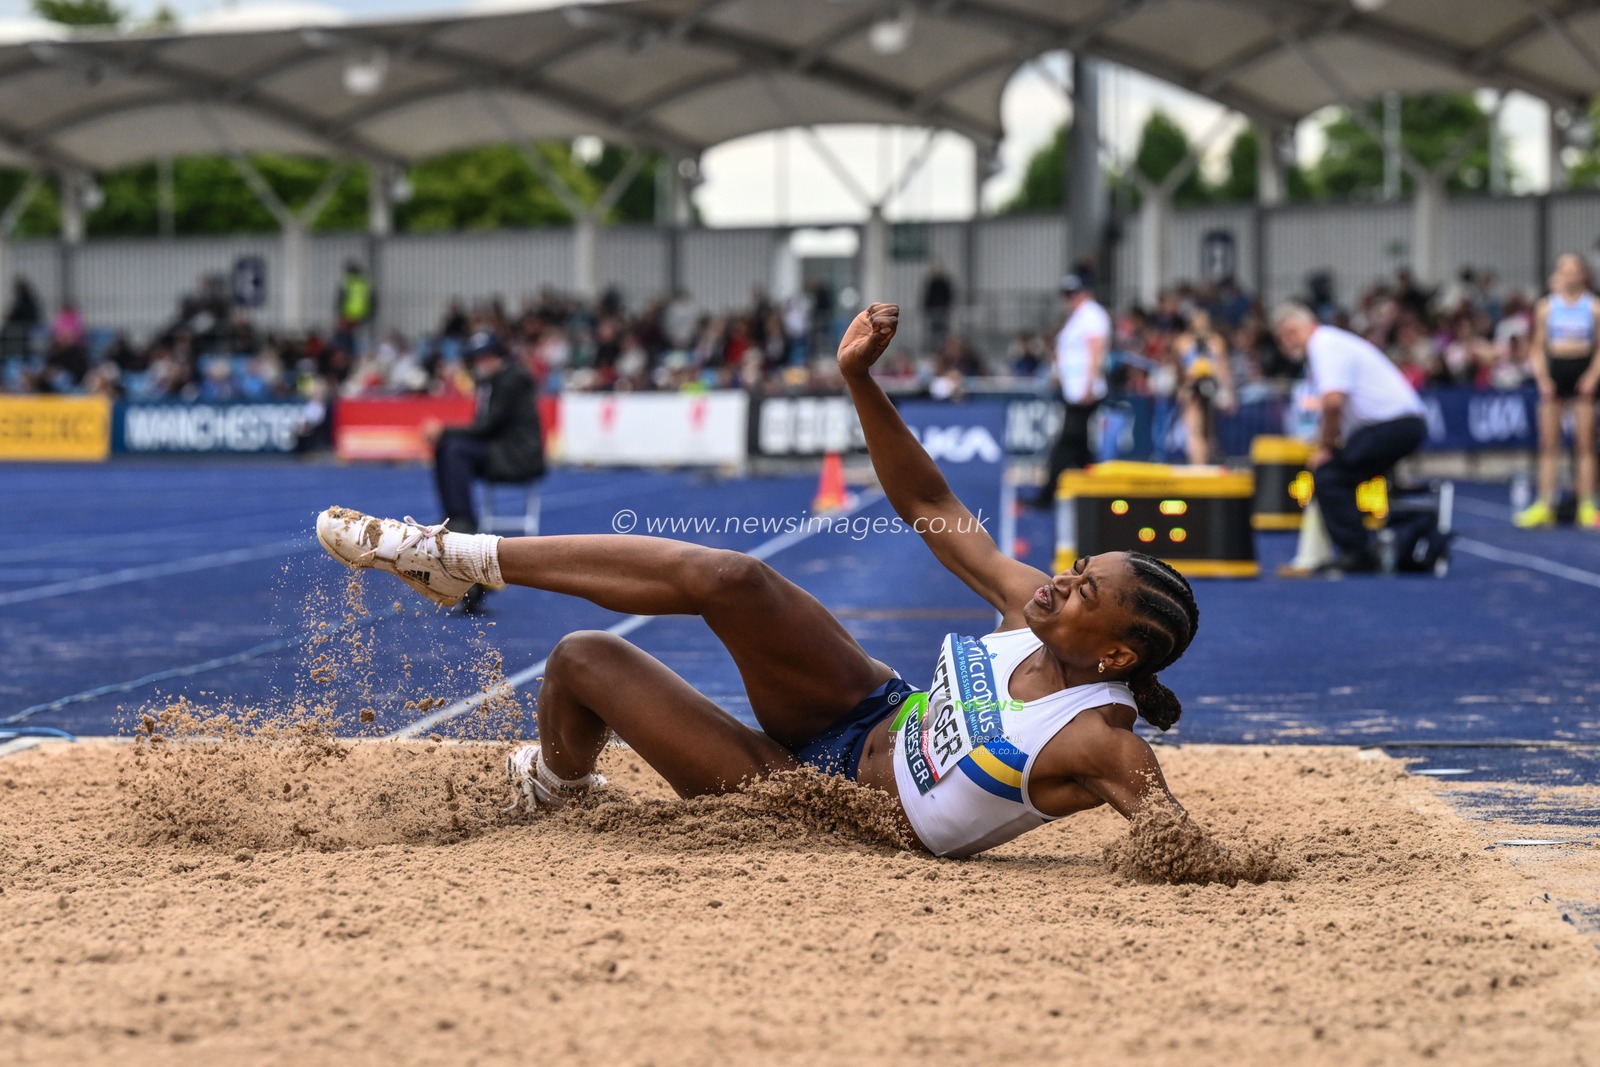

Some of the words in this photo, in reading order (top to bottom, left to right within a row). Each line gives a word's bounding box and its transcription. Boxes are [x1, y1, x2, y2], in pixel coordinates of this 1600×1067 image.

[125, 404, 304, 451] MANCHESTE
[912, 426, 1001, 463] KA
[958, 656, 972, 699] PROCESSING
[968, 709, 980, 737] TIMING
[906, 704, 930, 784] CHESTER
